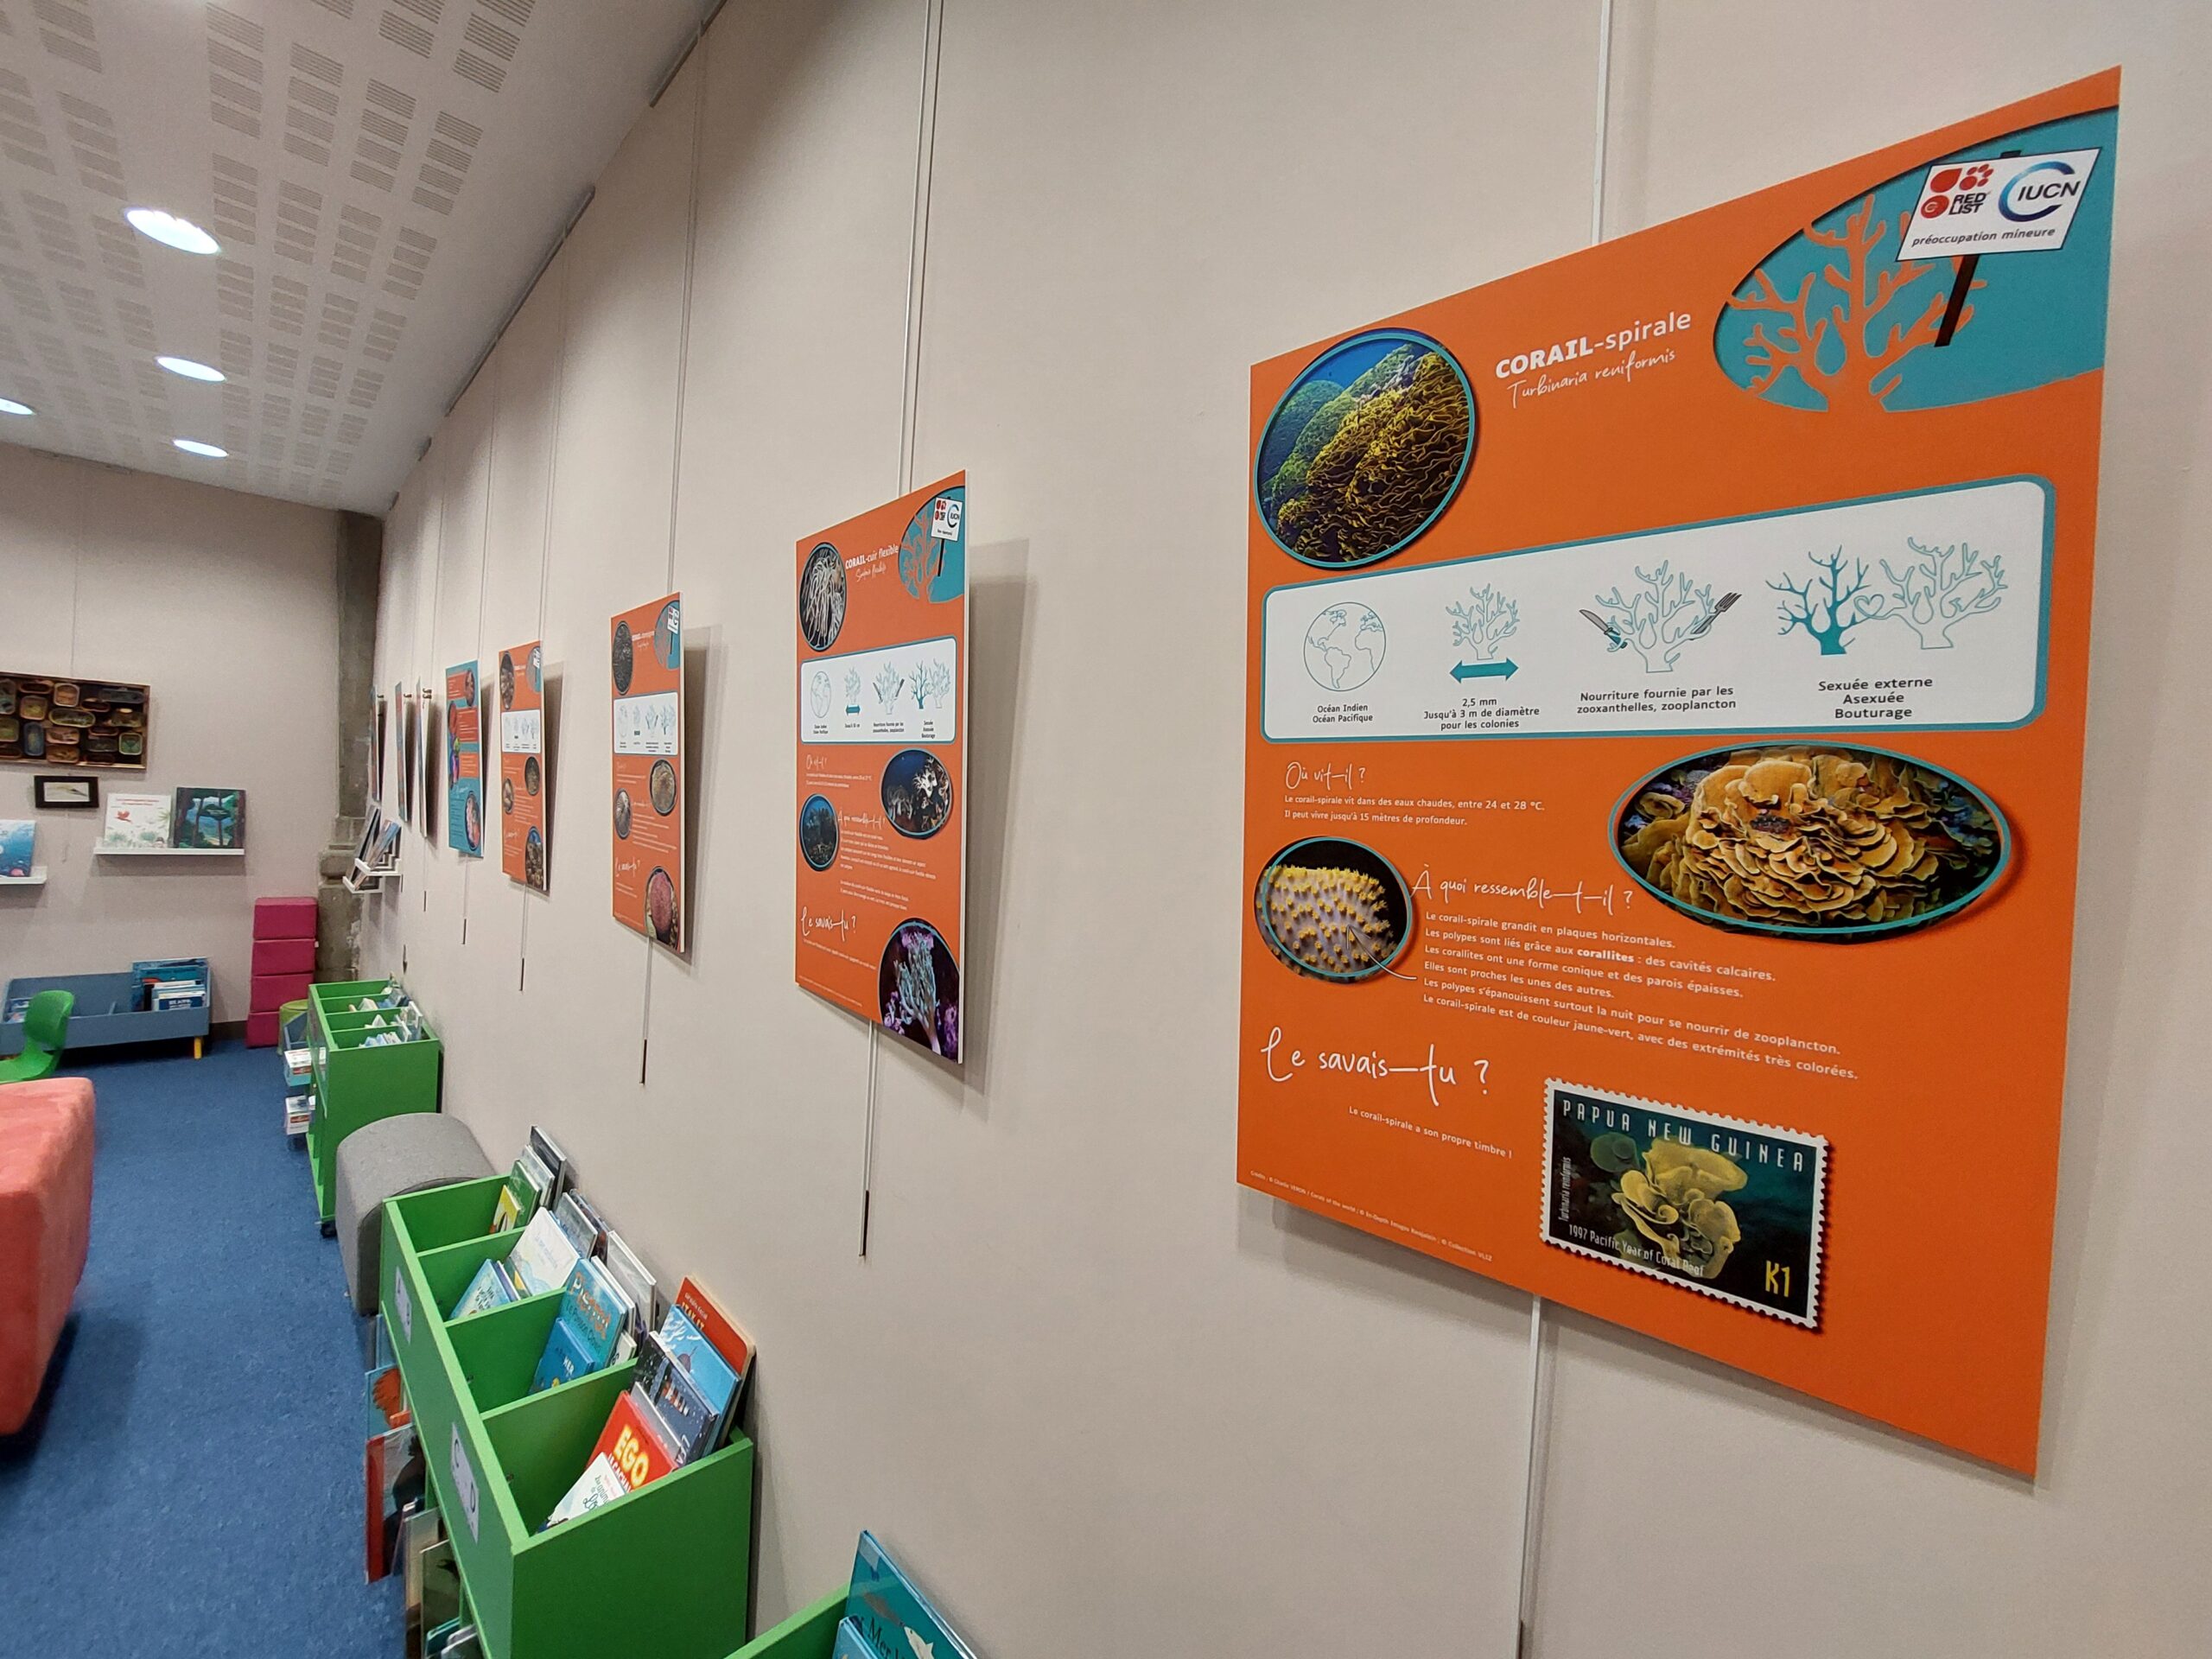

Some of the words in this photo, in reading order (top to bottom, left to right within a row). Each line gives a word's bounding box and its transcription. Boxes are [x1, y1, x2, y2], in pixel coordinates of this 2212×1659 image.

[1954, 193, 1986, 204] RED
[2018, 181, 2081, 201] IUCN
[1948, 203, 1983, 215] LIST
[1911, 227, 1997, 247] préoccupation
[2001, 227, 2056, 240] mineure
[1496, 311, 1691, 378] CORAIL-spirale
[1507, 372, 1587, 409] Turbinaria
[1595, 348, 1675, 382] reniformis
[1580, 690, 1639, 702] Nourriture
[1644, 688, 1687, 699] fournie
[1692, 688, 1712, 699] par
[1716, 685, 1733, 696] les
[1819, 679, 1868, 691] Sexuée
[1875, 677, 1933, 690] externe
[1318, 703, 1339, 714] Océan
[1343, 702, 1368, 712] Indien
[1462, 698, 1476, 708] 2,5
[1479, 697, 1497, 706] mm
[1577, 702, 1656, 715] zooxanthelles,
[1662, 699, 1736, 712] zooplancton
[1843, 692, 1904, 705] Asexuée
[1313, 713, 1336, 723] Océan
[1338, 712, 1373, 724] Pacifique
[1424, 709, 1457, 721] Jusqu'à
[1482, 708, 1492, 717] de
[1496, 705, 1540, 716] diamètre
[1440, 721, 1461, 731] pour
[1465, 720, 1477, 729] les
[1480, 718, 1520, 729] colonies
[1835, 706, 1912, 720] Bouturage
[1286, 761, 1307, 789] Où
[1358, 767, 1366, 783] ?
[1285, 795, 1293, 804] Le
[1295, 795, 1342, 806] corail-spirale
[1344, 797, 1355, 805] vit
[1357, 797, 1376, 805] dans
[1378, 798, 1392, 806] des
[1417, 798, 1455, 809] chaudes,
[1458, 800, 1483, 809] entre
[1485, 800, 1497, 810] 24
[1500, 801, 1510, 810] et
[1514, 801, 1527, 810] 28
[1293, 810, 1308, 820] peut
[1311, 810, 1329, 819] vivre
[1360, 812, 1370, 821] 15
[1371, 812, 1400, 823] mètres
[1402, 814, 1413, 823] de
[1416, 815, 1467, 825] profondeur.
[1440, 879, 1466, 903] quoi
[1624, 890, 1633, 909] ?
[1426, 912, 1436, 920] Le
[1439, 913, 1498, 928] corail-spirale
[1501, 921, 1537, 933] grandit
[1541, 925, 1553, 934] en
[1557, 925, 1598, 939] plaques
[1602, 931, 1675, 949] horizontales.
[1426, 928, 1440, 938] Les
[1443, 931, 1477, 944] polypes
[1480, 936, 1501, 945] sont
[1504, 937, 1521, 948] liés
[1524, 940, 1552, 952] grâce
[1555, 945, 1573, 955] aux
[1577, 947, 1635, 963] corallites
[1645, 956, 1665, 967] des
[1669, 959, 1713, 973] cavités
[1716, 965, 1776, 982] calcaires.
[1425, 944, 1440, 955] Les
[1442, 946, 1484, 961] corallites
[1487, 953, 1503, 963] ont
[1506, 957, 1524, 967] une
[1528, 958, 1559, 971] forme
[1562, 963, 1604, 978] conique
[1608, 969, 1619, 980] et
[1624, 972, 1643, 983] des
[1646, 976, 1683, 989] parois
[1687, 979, 1744, 997] épaisses.
[1425, 962, 1445, 972] Elles
[1447, 966, 1467, 976] sont
[1471, 968, 1507, 982] proches
[1510, 974, 1524, 984] les
[1528, 977, 1551, 988] unes
[1555, 982, 1573, 992] des
[1577, 985, 1614, 999] autres.
[1424, 978, 1439, 988] Les
[1441, 981, 1475, 995] polypes
[1554, 1000, 1593, 1014] surtout
[1598, 1006, 1607, 1016] la
[1611, 1009, 1634, 1020] nuit
[1637, 1014, 1664, 1027] pour
[1669, 1018, 1681, 1028] se
[1687, 1022, 1730, 1036] nourrir
[1734, 1027, 1750, 1039] de
[1754, 1033, 1840, 1055] zooplancton.
[1423, 994, 1433, 1004] Le
[1437, 996, 1496, 1015] corail-spirale
[1498, 1008, 1513, 1018] est
[1517, 1010, 1529, 1020] de
[1532, 1014, 1570, 1028] couleur
[1573, 1019, 1633, 1040] jaune-vert,
[1637, 1033, 1663, 1045] avec
[1668, 1037, 1688, 1049] des
[1692, 1040, 1760, 1062] extrémités
[1764, 1054, 1791, 1067] très
[1796, 1060, 1859, 1079] colorées.
[1261, 1027, 1306, 1082] Le
[1474, 1060, 1489, 1095] ?
[1349, 1106, 1358, 1116] Le
[1360, 1109, 1413, 1131] corail-spirale
[1424, 1128, 1439, 1138] son
[1441, 1133, 1471, 1147] propre
[1475, 1141, 1506, 1157] timbre
[1562, 1100, 1630, 1132] PAPUA
[1648, 1119, 1691, 1146] NEW
[1712, 1134, 1803, 1173] GUINEA
[1568, 1224, 1587, 1241] 1997
[1591, 1230, 1620, 1249] Pacific
[1622, 1241, 1642, 1256] Year
[1643, 1249, 1654, 1262] of
[1656, 1251, 1681, 1269] Coral
[1682, 1260, 1704, 1277] Reef
[1765, 1260, 1790, 1297] K1
[613, 1424, 649, 1489] EGO
